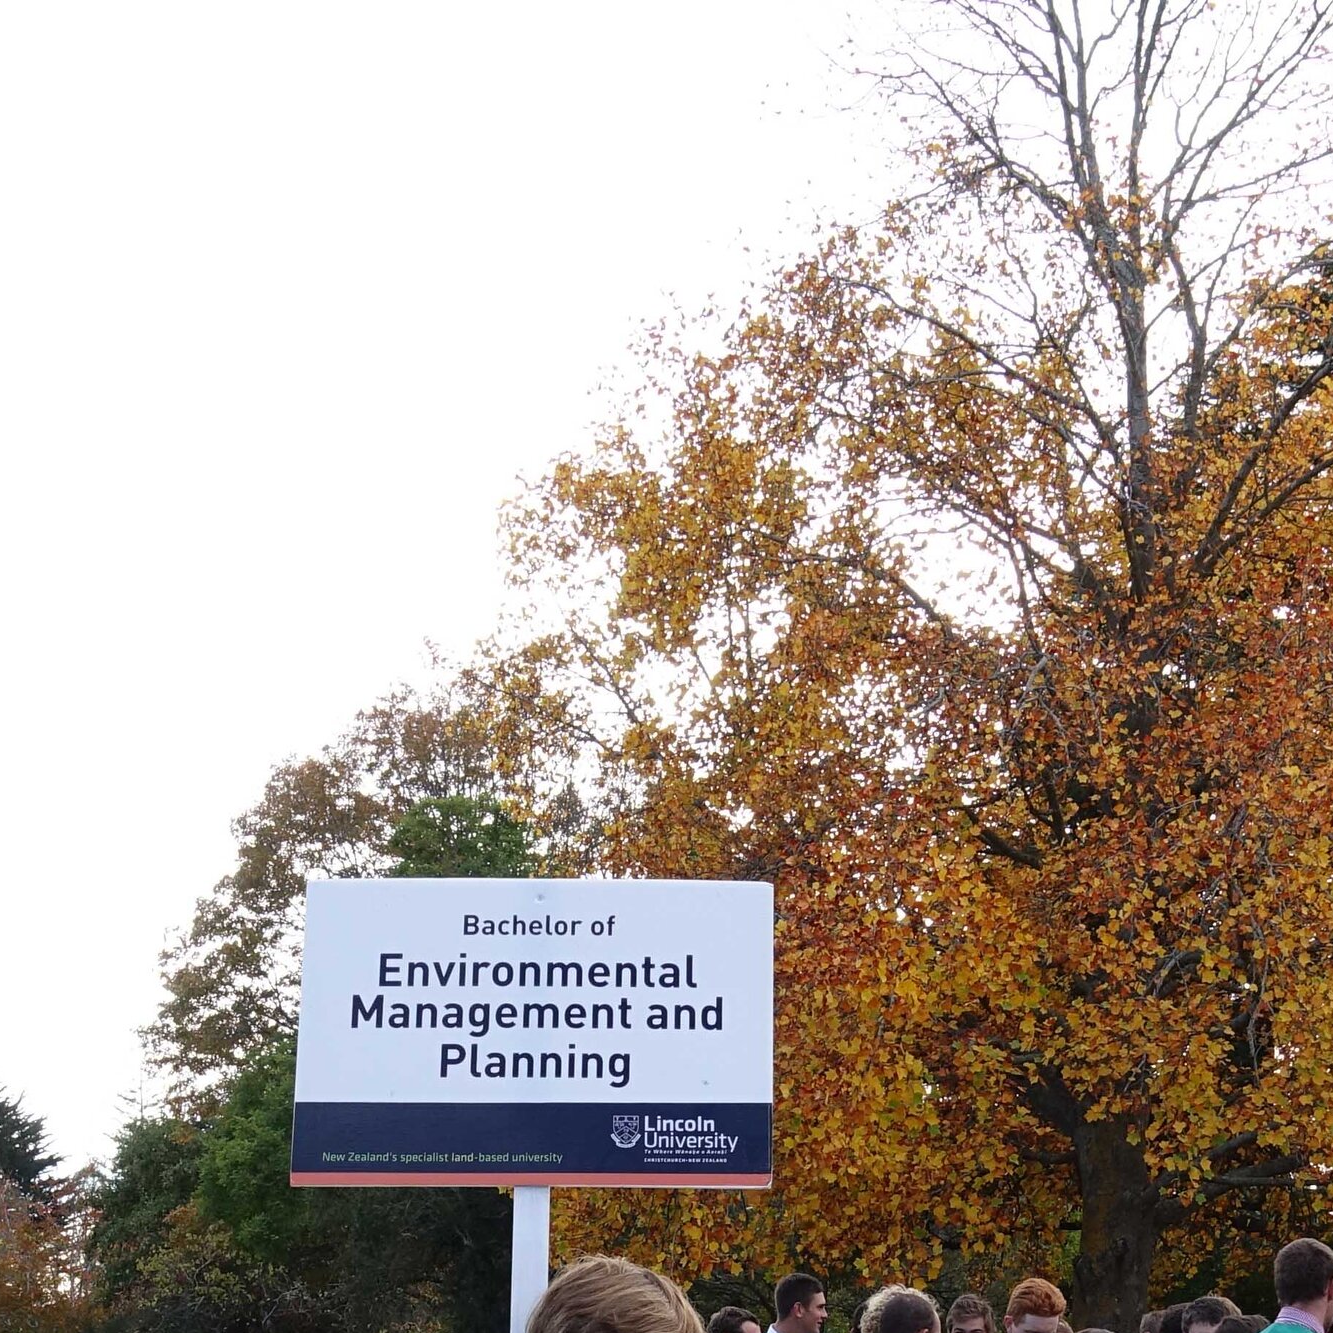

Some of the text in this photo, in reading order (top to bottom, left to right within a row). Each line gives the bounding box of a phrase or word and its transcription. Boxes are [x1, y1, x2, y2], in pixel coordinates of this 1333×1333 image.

[463, 914, 616, 936] Bachelor of
[378, 953, 698, 989] Environmental
[351, 994, 723, 1037] Management and
[440, 1044, 631, 1088] Planning
[644, 1115, 715, 1132] Lincoln
[644, 1132, 738, 1153] University
[322, 1151, 563, 1164] New Zealand's specialist land-based university
